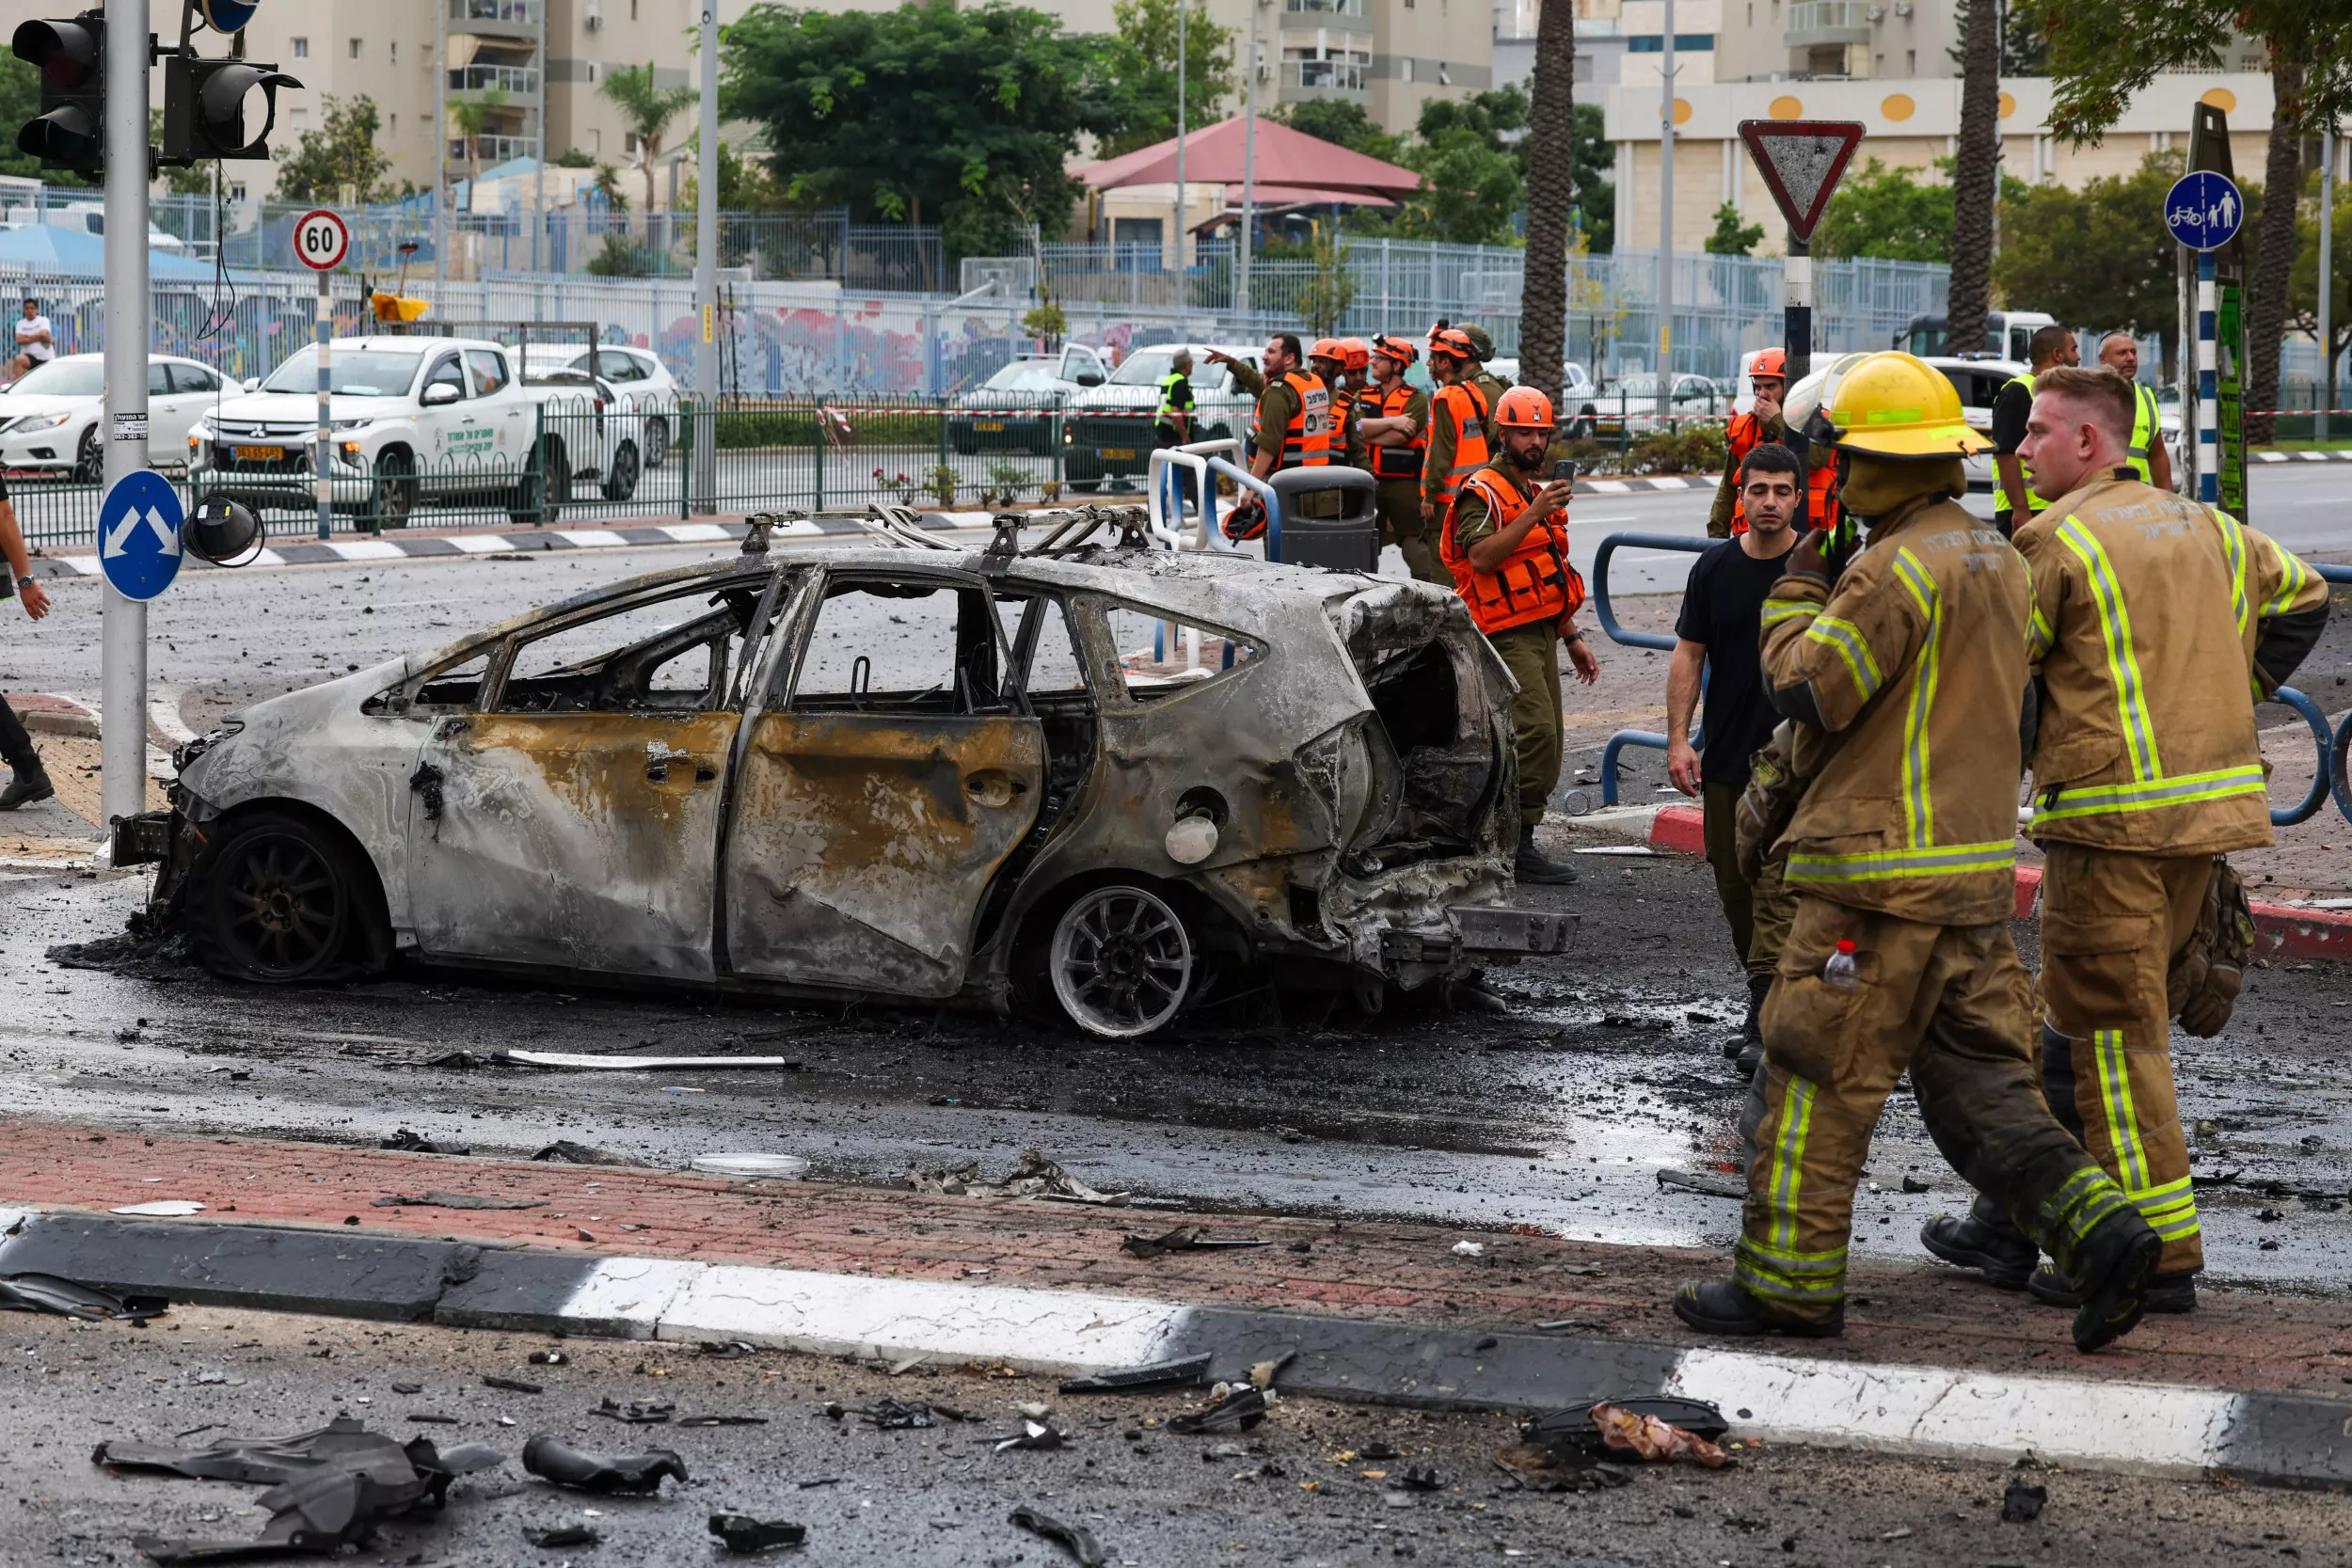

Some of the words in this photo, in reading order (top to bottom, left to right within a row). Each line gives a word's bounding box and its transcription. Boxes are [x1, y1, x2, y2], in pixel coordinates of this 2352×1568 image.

[307, 227, 332, 252] 60
[2096, 503, 2153, 524] והצלה
[1921, 530, 1972, 554] והצלה
[2133, 519, 2197, 542] לישראל
